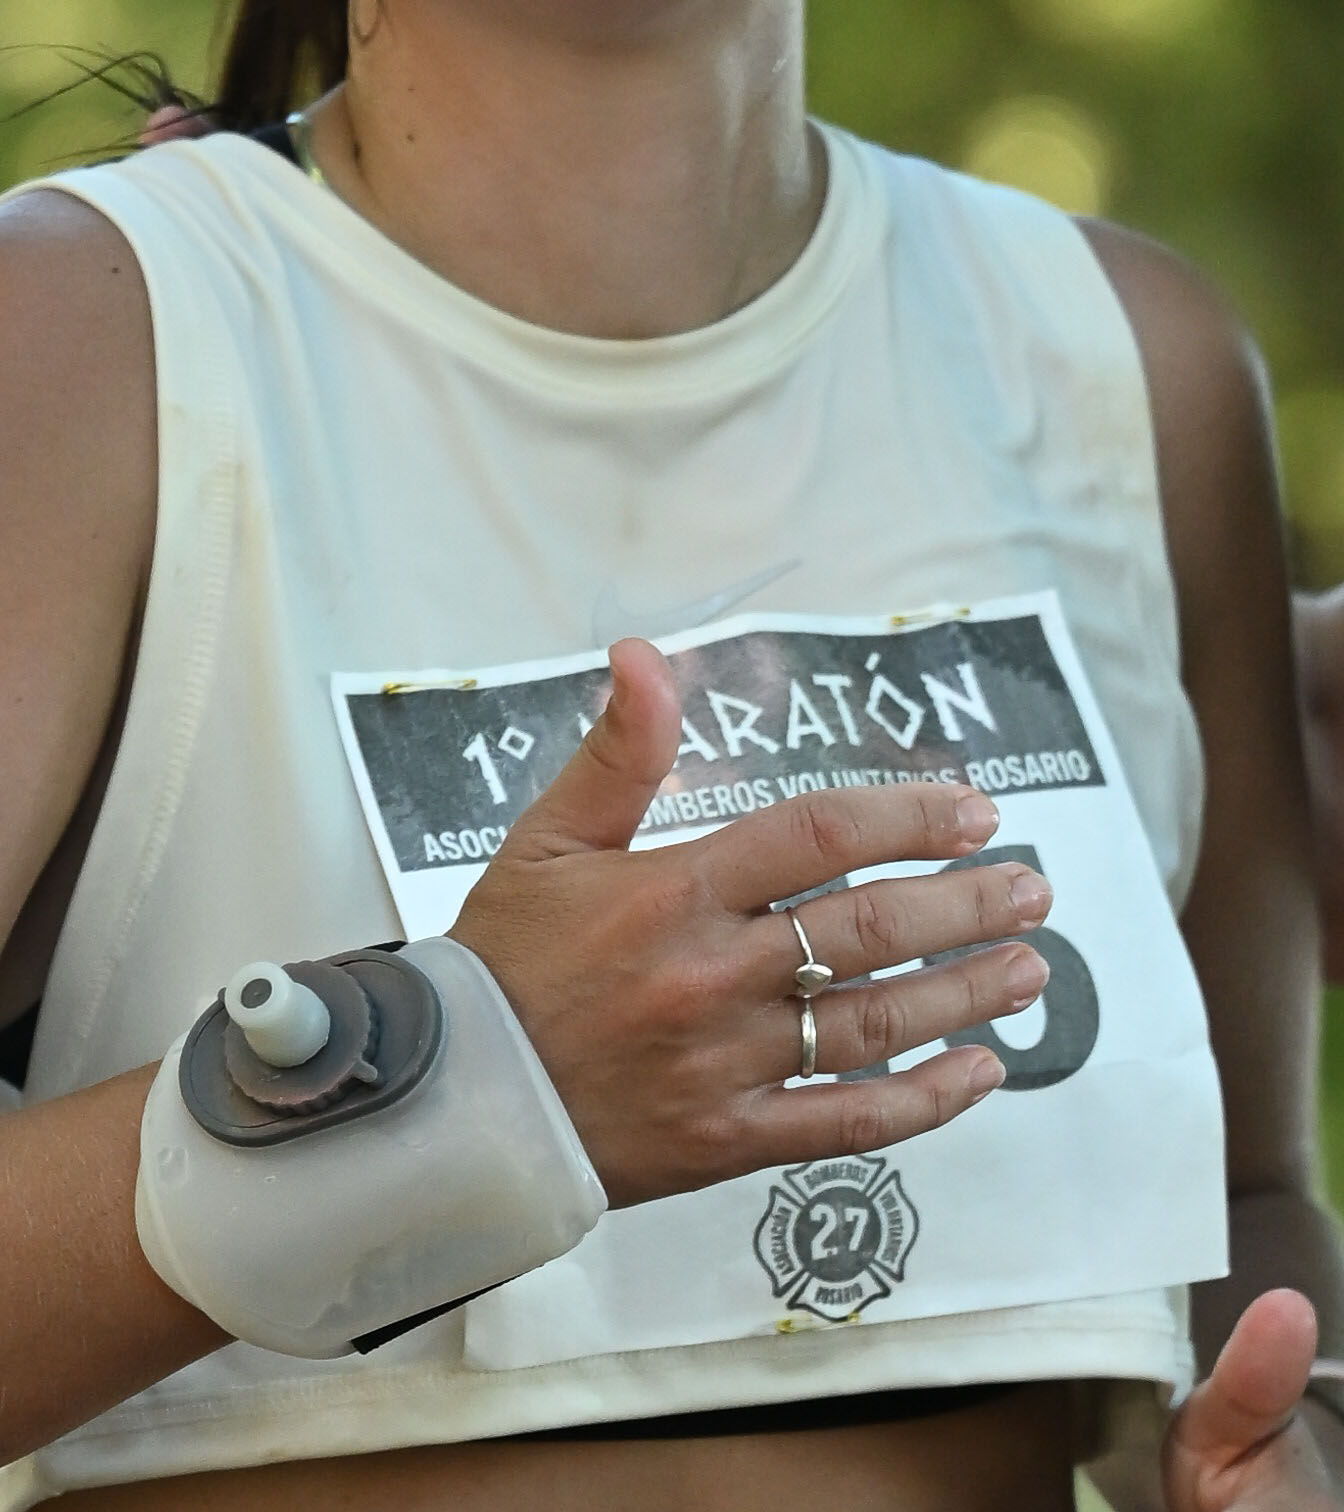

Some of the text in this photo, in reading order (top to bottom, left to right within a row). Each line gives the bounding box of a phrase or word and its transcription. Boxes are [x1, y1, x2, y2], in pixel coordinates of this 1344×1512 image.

[577, 651, 998, 769] ARATÓN
[637, 776, 775, 830] MBEROS
[964, 749, 1091, 792] ROSARIO
[809, 1203, 869, 1261] 27
